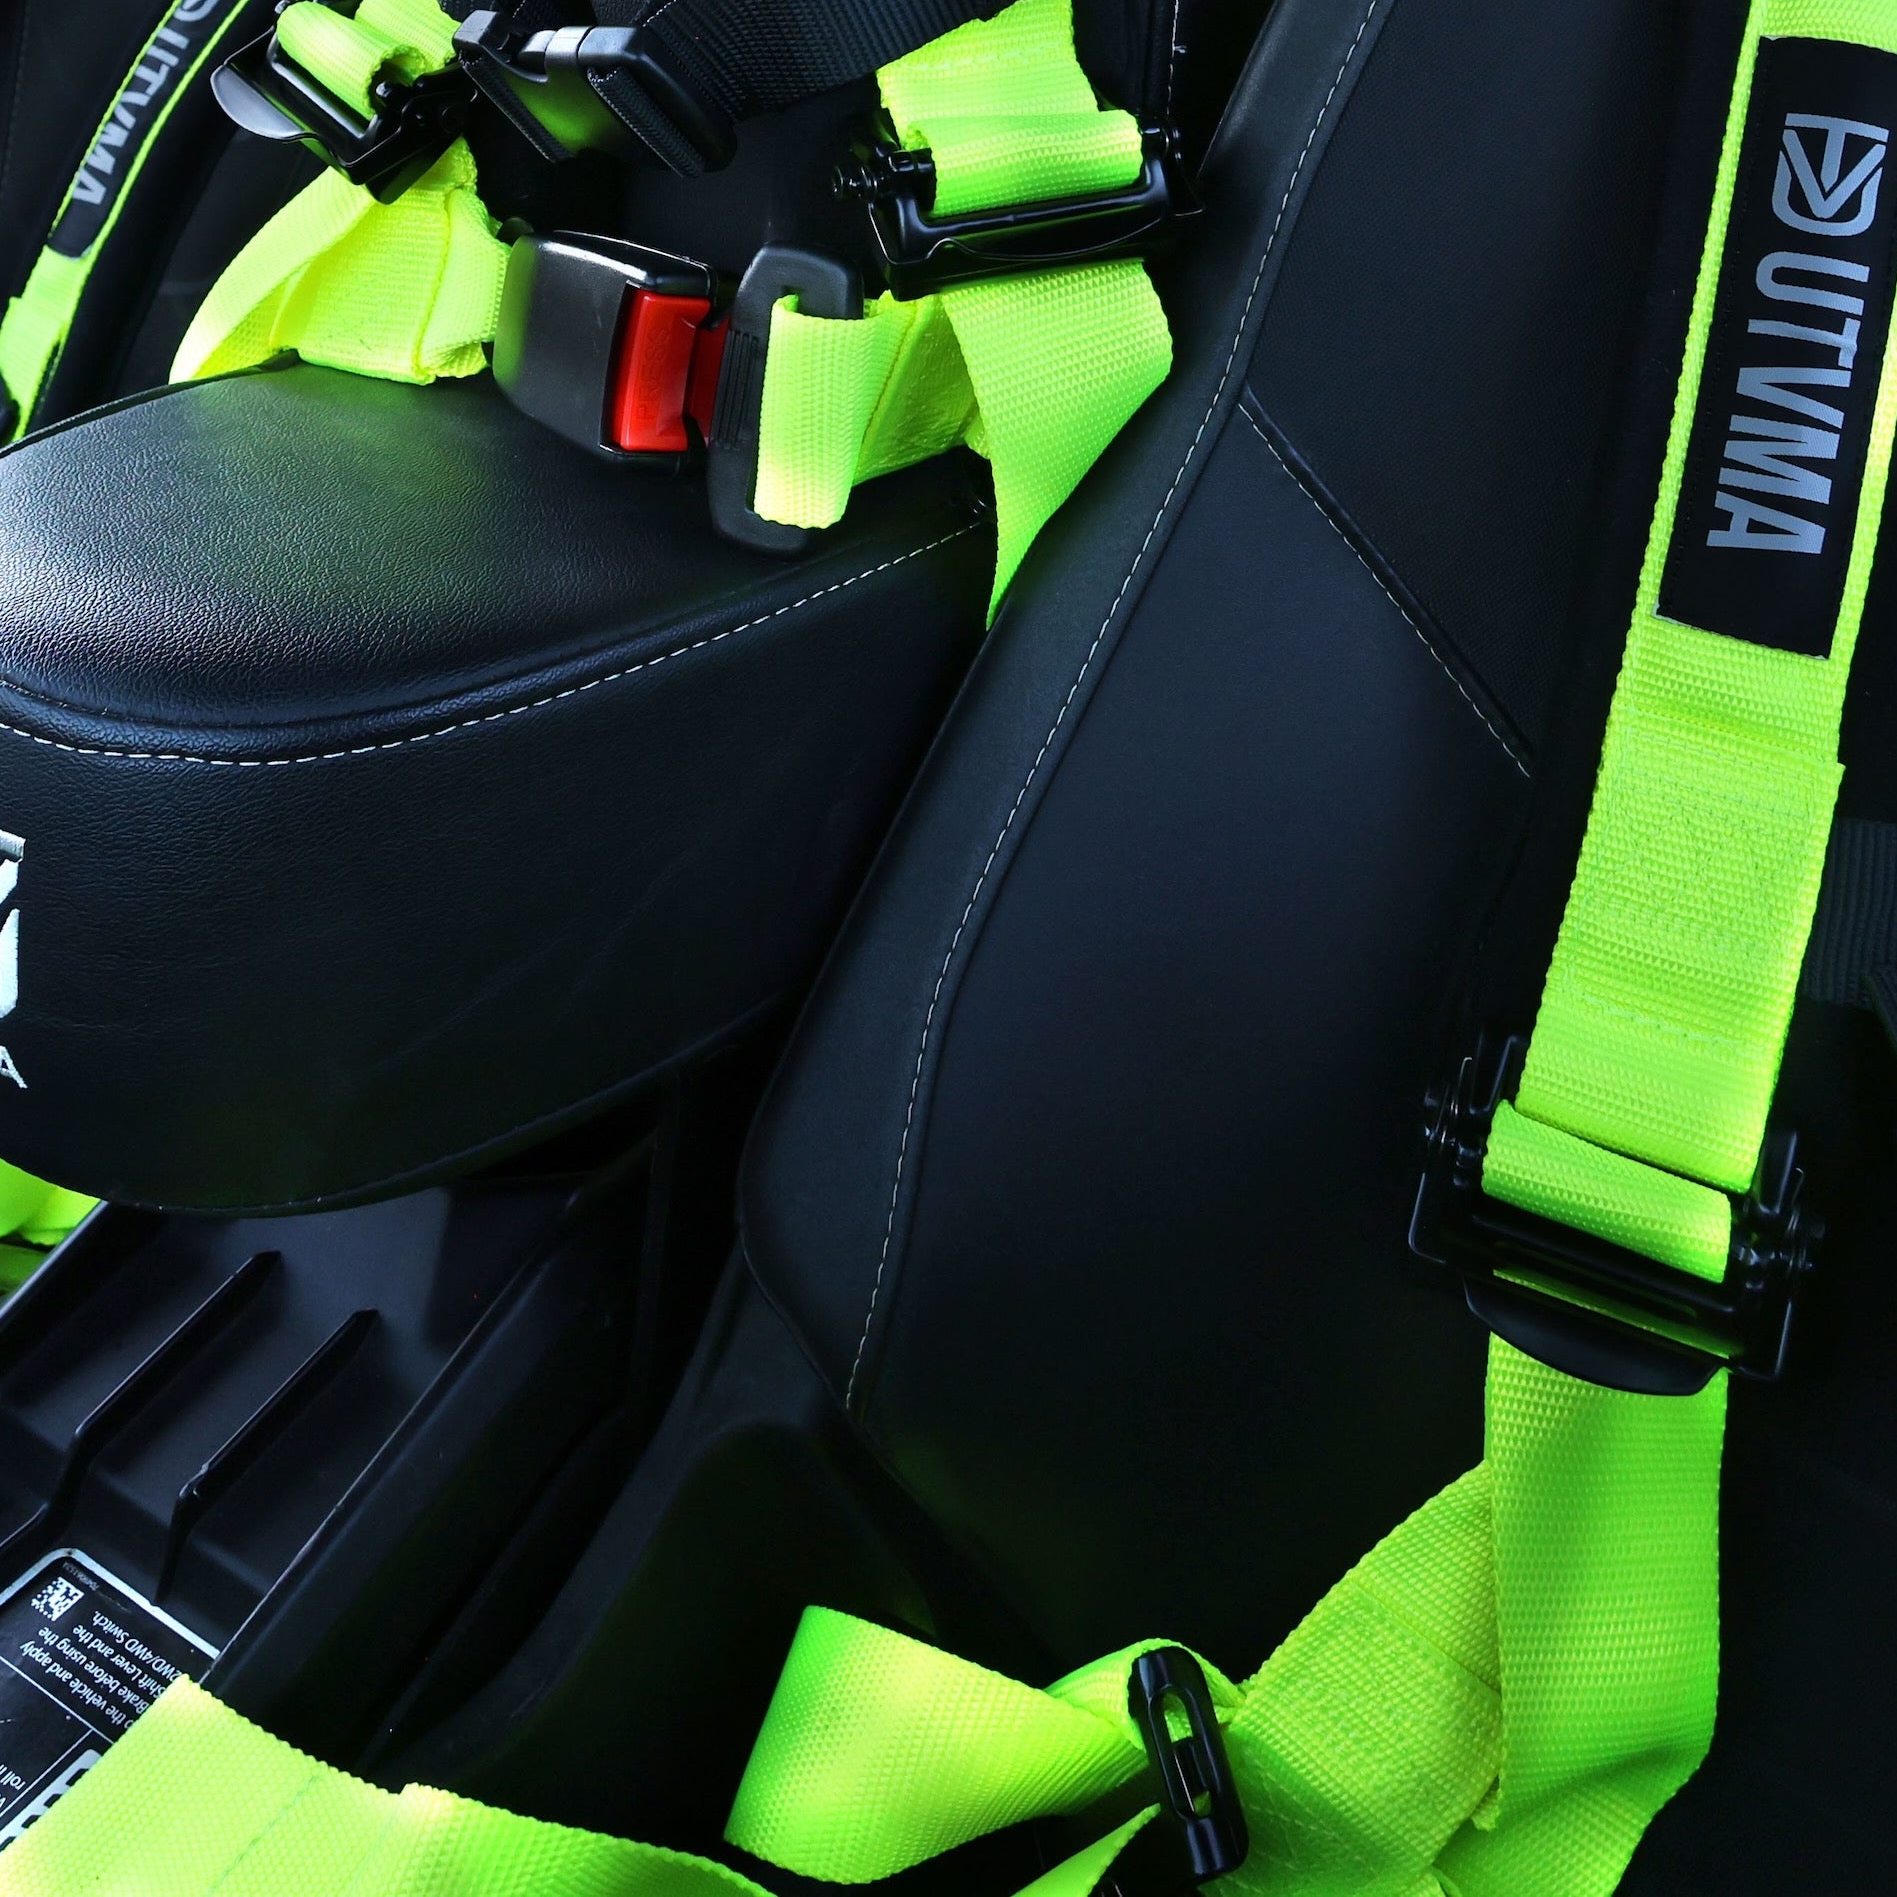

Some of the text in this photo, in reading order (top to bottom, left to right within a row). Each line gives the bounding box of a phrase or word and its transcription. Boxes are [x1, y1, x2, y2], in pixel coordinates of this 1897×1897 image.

[71, 27, 190, 206] UTVMA
[1706, 250, 1871, 554] UTVMA
[19, 1640, 127, 1726] the vehicle and apply
[38, 1626, 150, 1714] Brake before using the
[72, 1624, 167, 1698] Shift Lever and the
[93, 1610, 182, 1683] 2WD/4WD Switch.
[0, 1770, 26, 1791] roll
